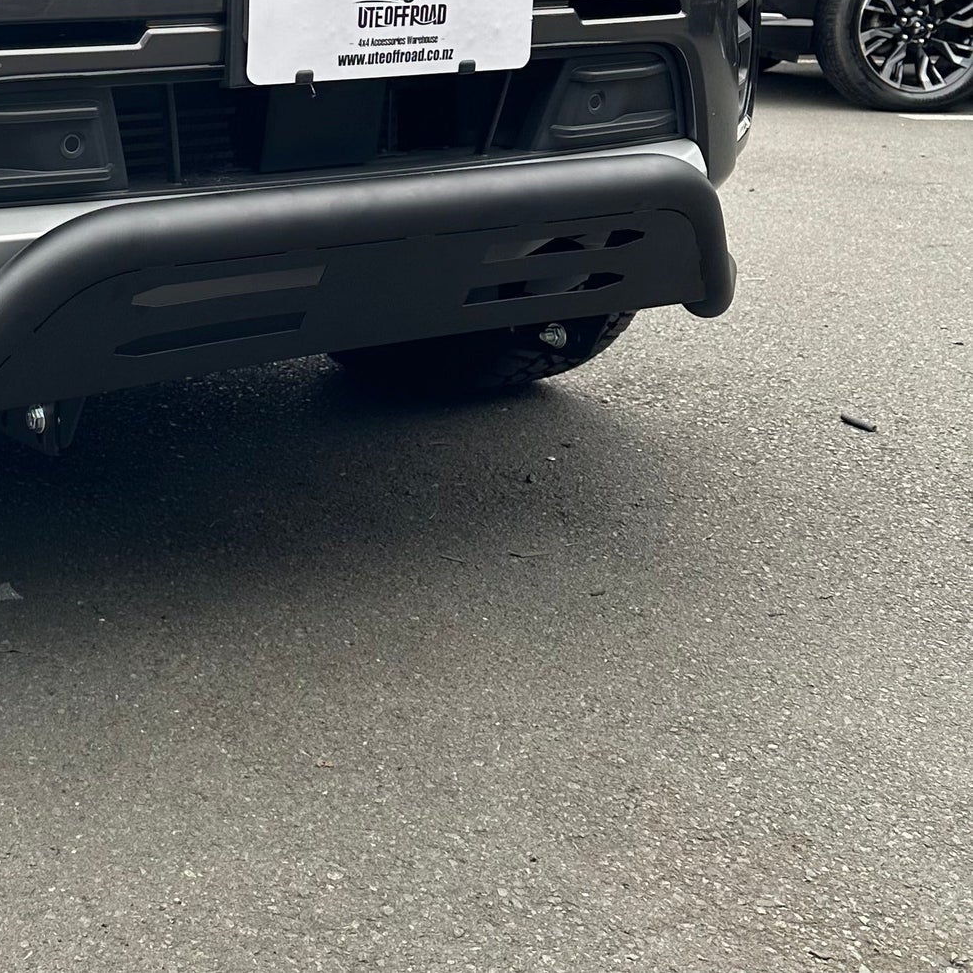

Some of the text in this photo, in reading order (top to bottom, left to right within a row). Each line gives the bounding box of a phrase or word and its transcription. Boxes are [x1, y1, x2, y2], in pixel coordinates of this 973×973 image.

[358, 4, 447, 28] UTEOFFROAD
[358, 36, 438, 47] 4x4 Accessories Warehouse
[338, 48, 454, 66] www.uteoffroad.co.nz
